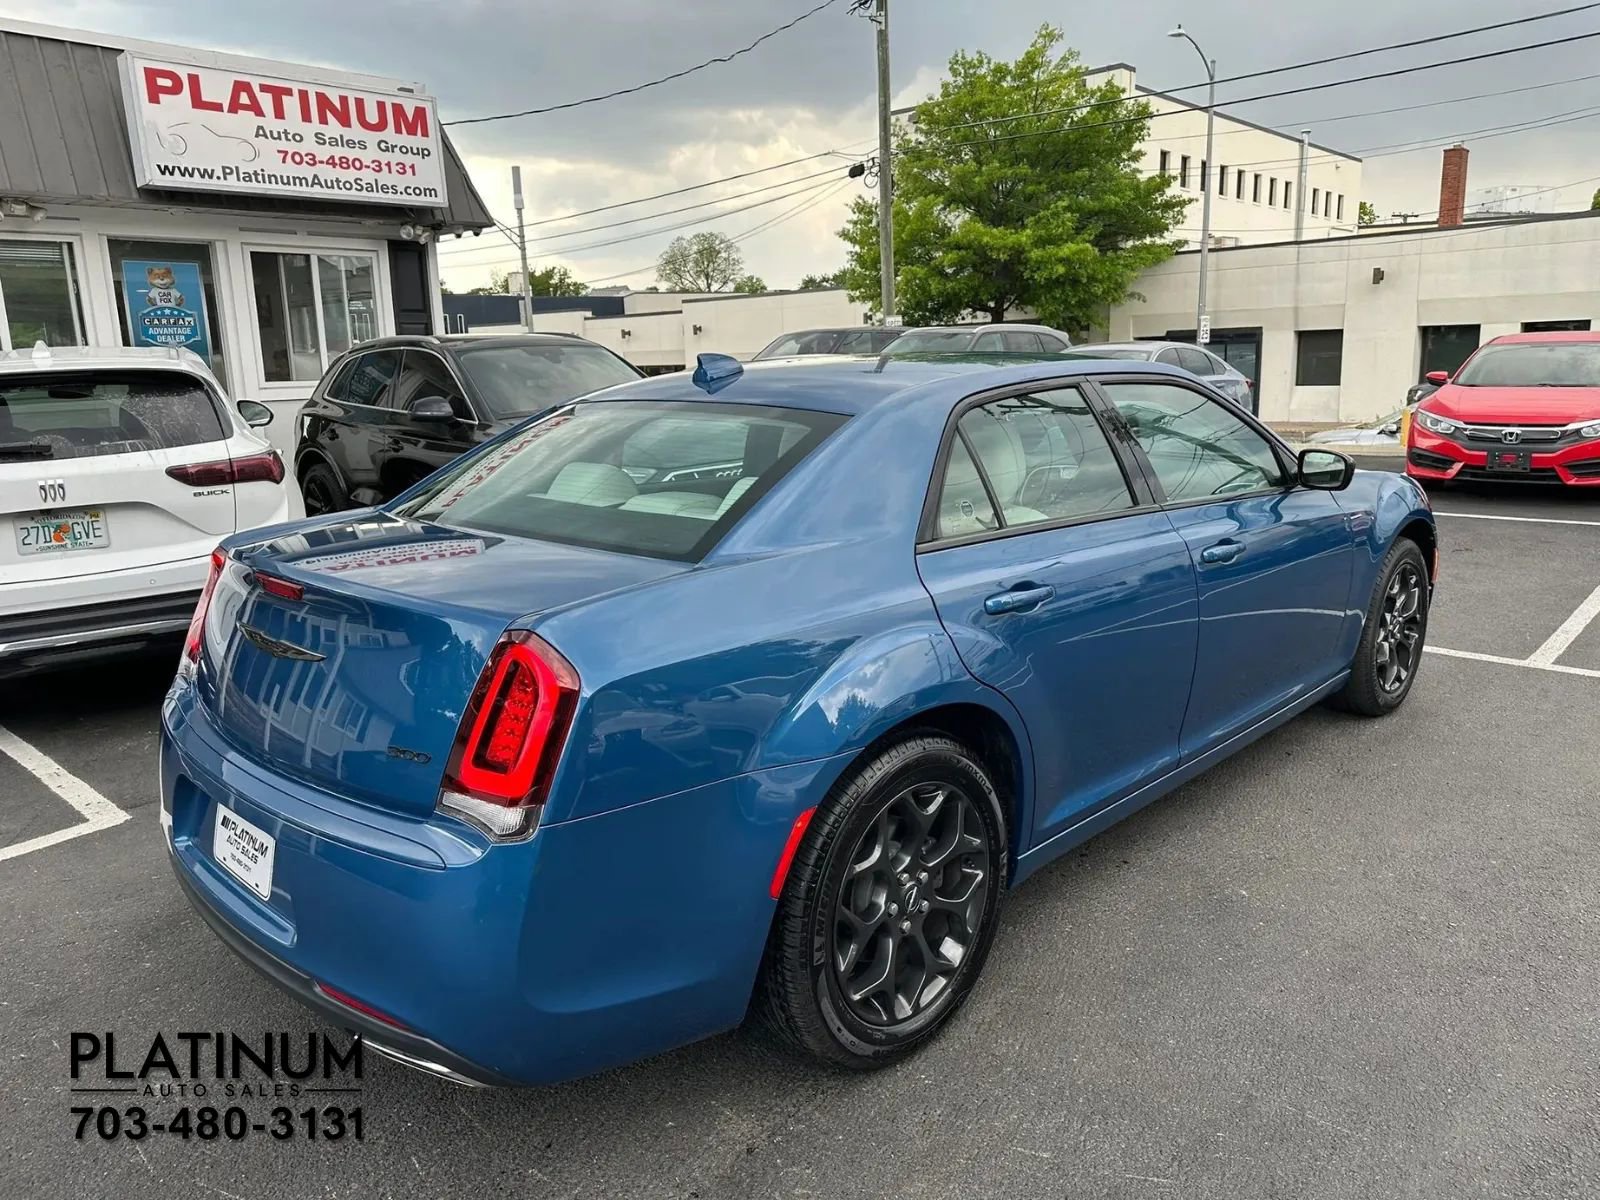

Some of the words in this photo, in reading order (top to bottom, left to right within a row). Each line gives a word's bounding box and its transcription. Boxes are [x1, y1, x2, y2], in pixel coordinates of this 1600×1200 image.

[143, 66, 430, 138] PLATINUM
[254, 125, 304, 144] Auto
[314, 131, 368, 151] Sales
[377, 139, 431, 159] Group
[276, 149, 417, 177] 703-480-3131
[156, 163, 438, 198] www.PlatinumAutoSales.com
[148, 327, 192, 335] ADVANTAGE
[193, 489, 230, 497] BUICK
[71, 520, 103, 541] GVE
[38, 543, 68, 552] SUNSHINE
[71, 541, 89, 549] STATE
[226, 834, 241, 851] AUTO
[240, 846, 259, 864] SALES
[229, 820, 269, 858] PLATINUM
